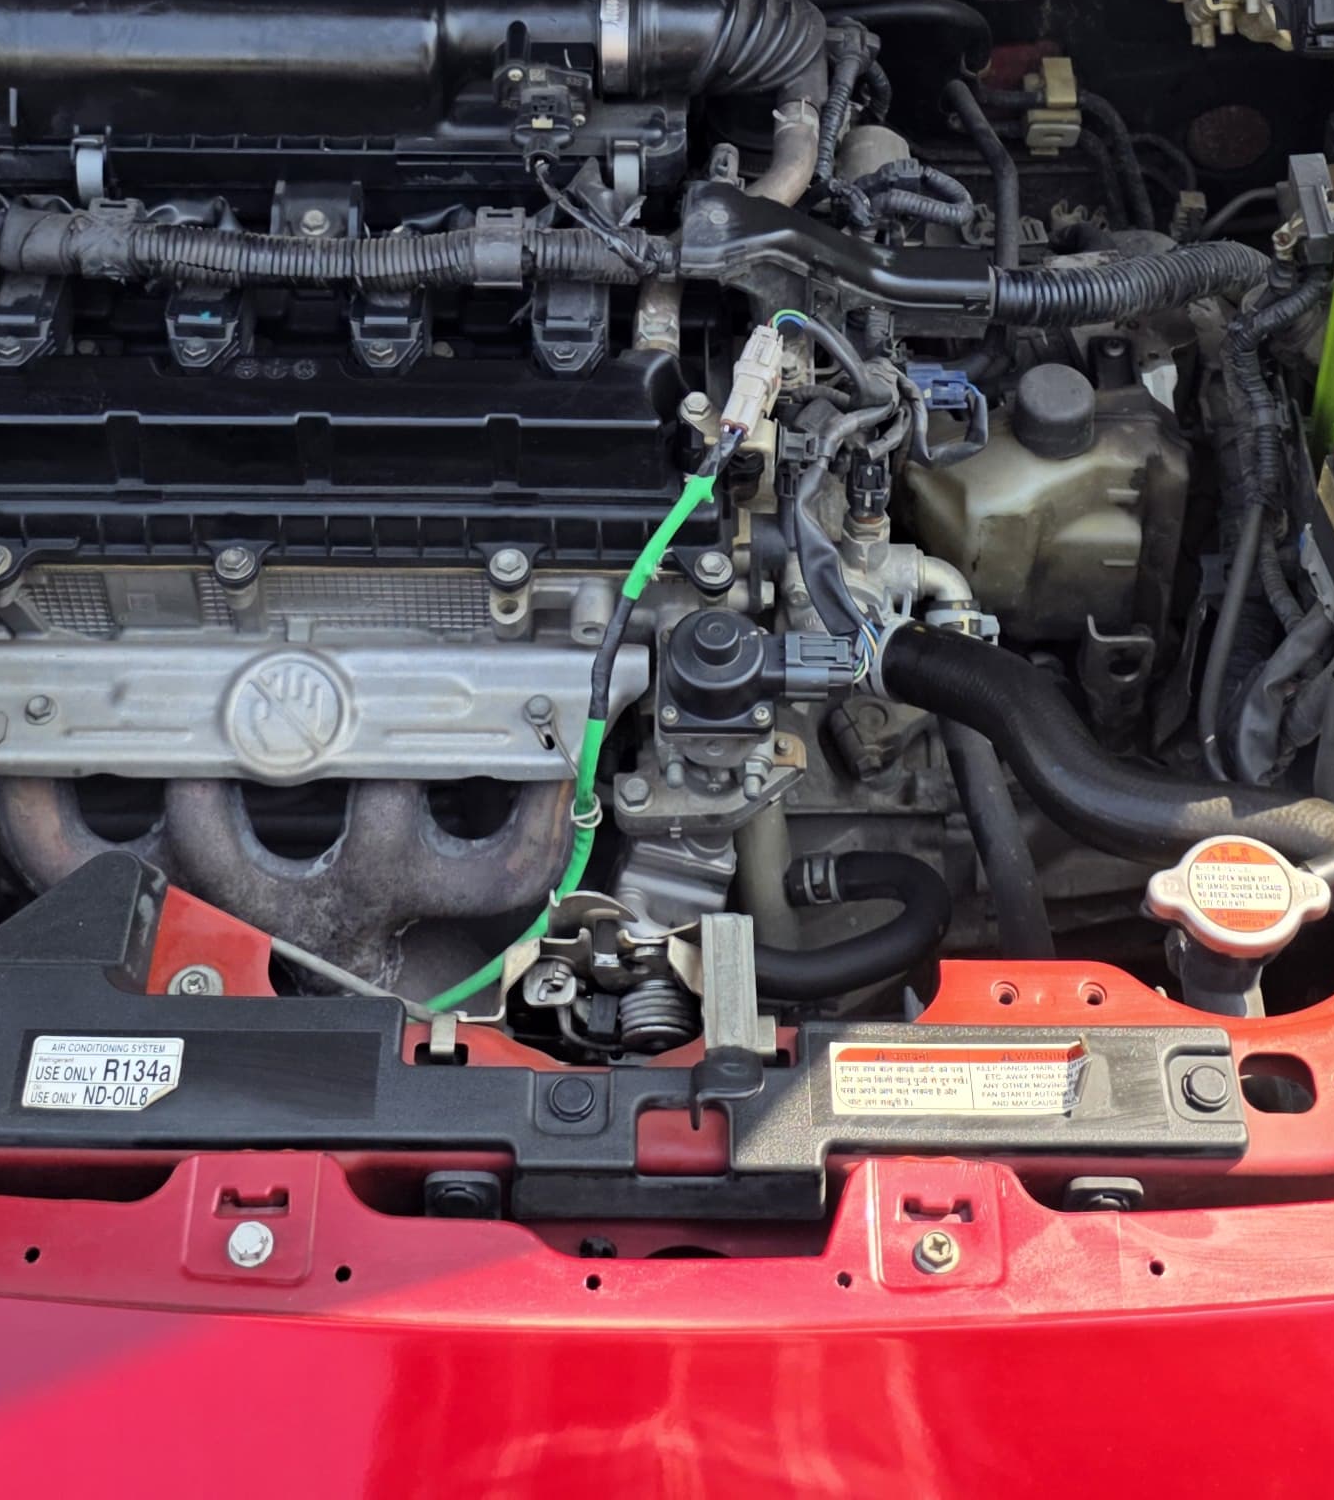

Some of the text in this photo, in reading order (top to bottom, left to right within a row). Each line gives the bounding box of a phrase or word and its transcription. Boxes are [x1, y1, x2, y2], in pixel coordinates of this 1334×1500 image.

[51, 1043, 166, 1053] AIR CONDITIONING SYSTEM
[35, 1058, 171, 1082] USE ONLY R134a
[30, 1085, 149, 1106] USE ONLY ND-OIL8
